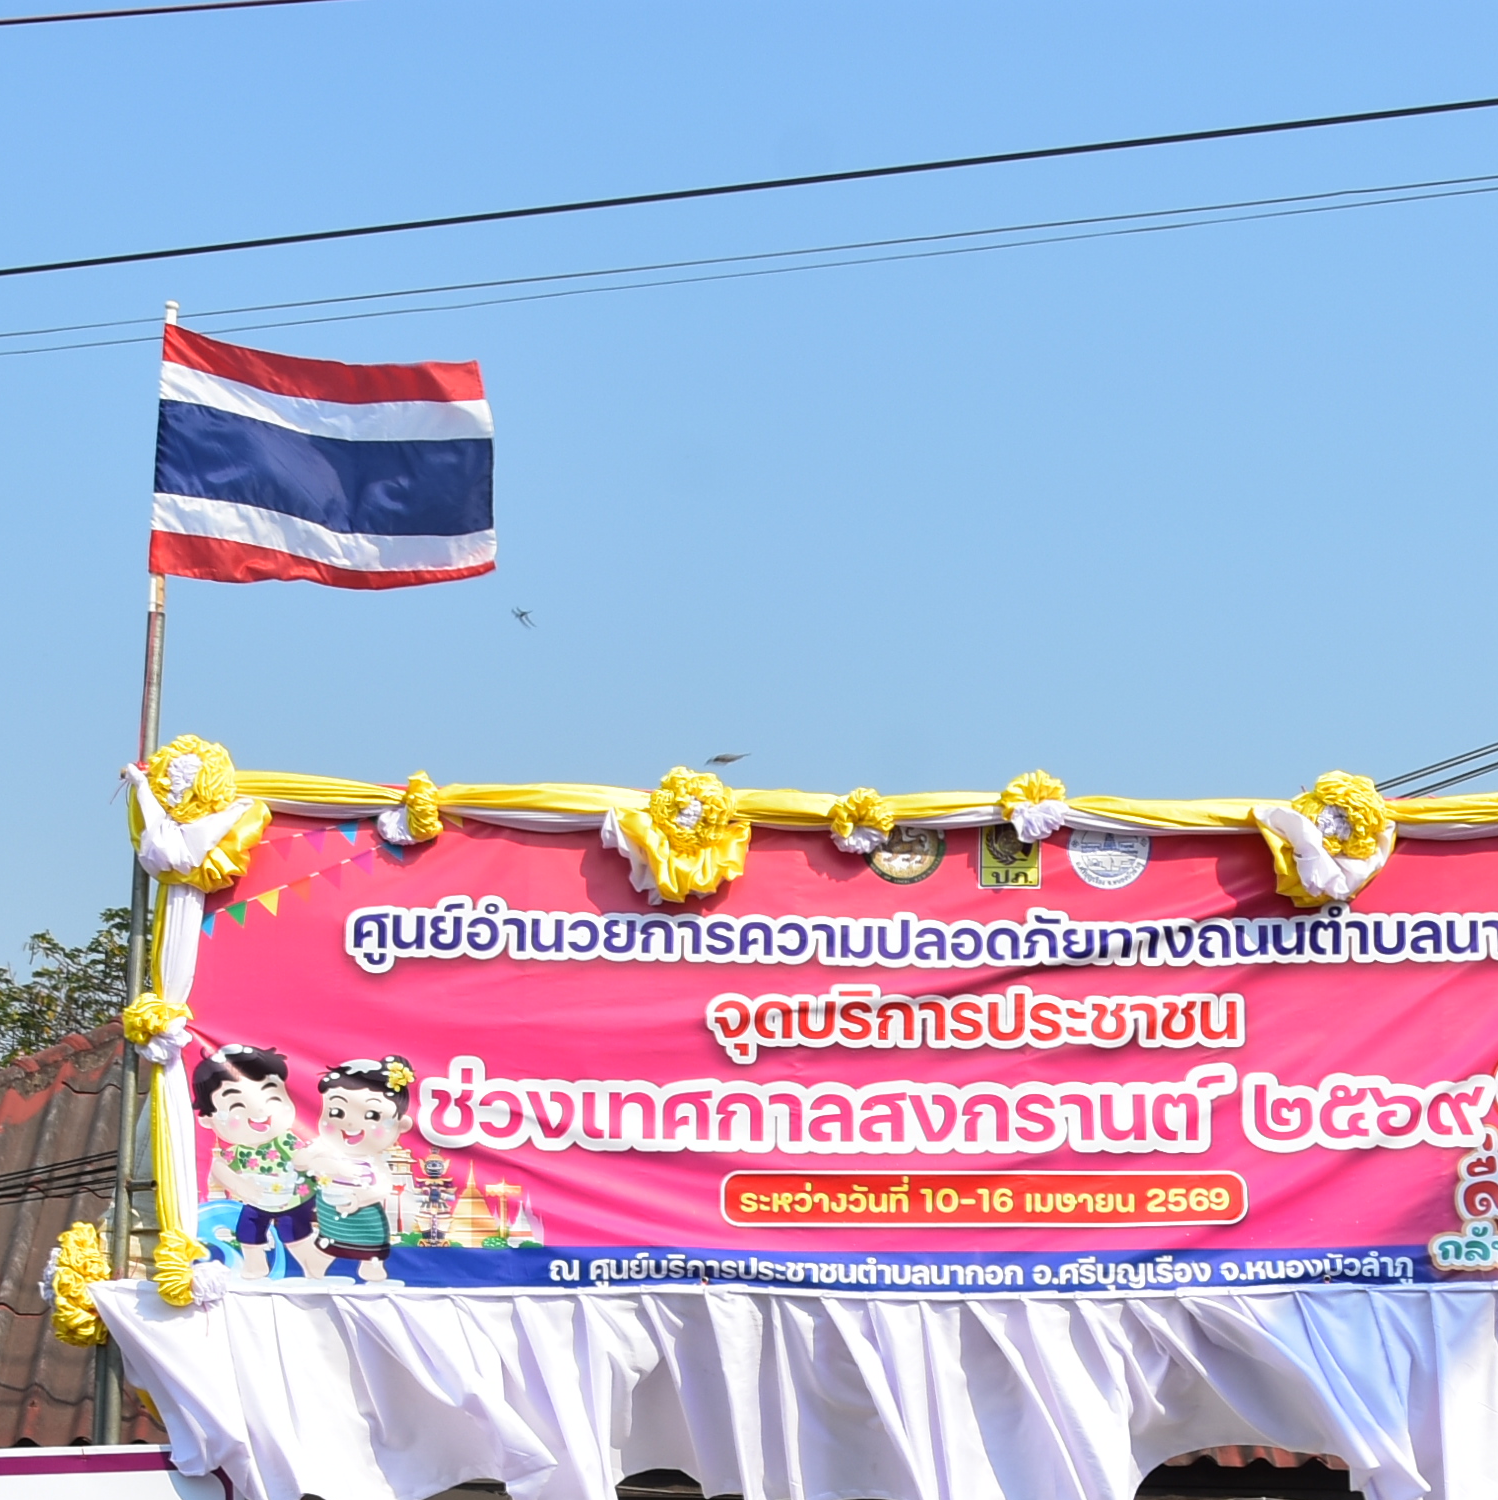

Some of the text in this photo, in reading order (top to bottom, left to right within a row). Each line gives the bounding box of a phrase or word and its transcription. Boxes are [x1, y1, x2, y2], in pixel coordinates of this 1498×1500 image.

[990, 869, 1033, 884] ปภ.
[713, 991, 1239, 1057] จุดบริการประชาชน
[428, 1059, 1486, 1145] ช่วงเทศกาลสงกรานต์ ๒๕๖๙
[739, 1177, 1231, 1214] ระหว่างวันที่ 10-16 เมษายน 2569
[549, 1250, 1414, 1292] ณ ศูนย์บริการประชาชนตำบลนากอก อ.ศรีบุญเรือง จ.หนองบัวลำภู
